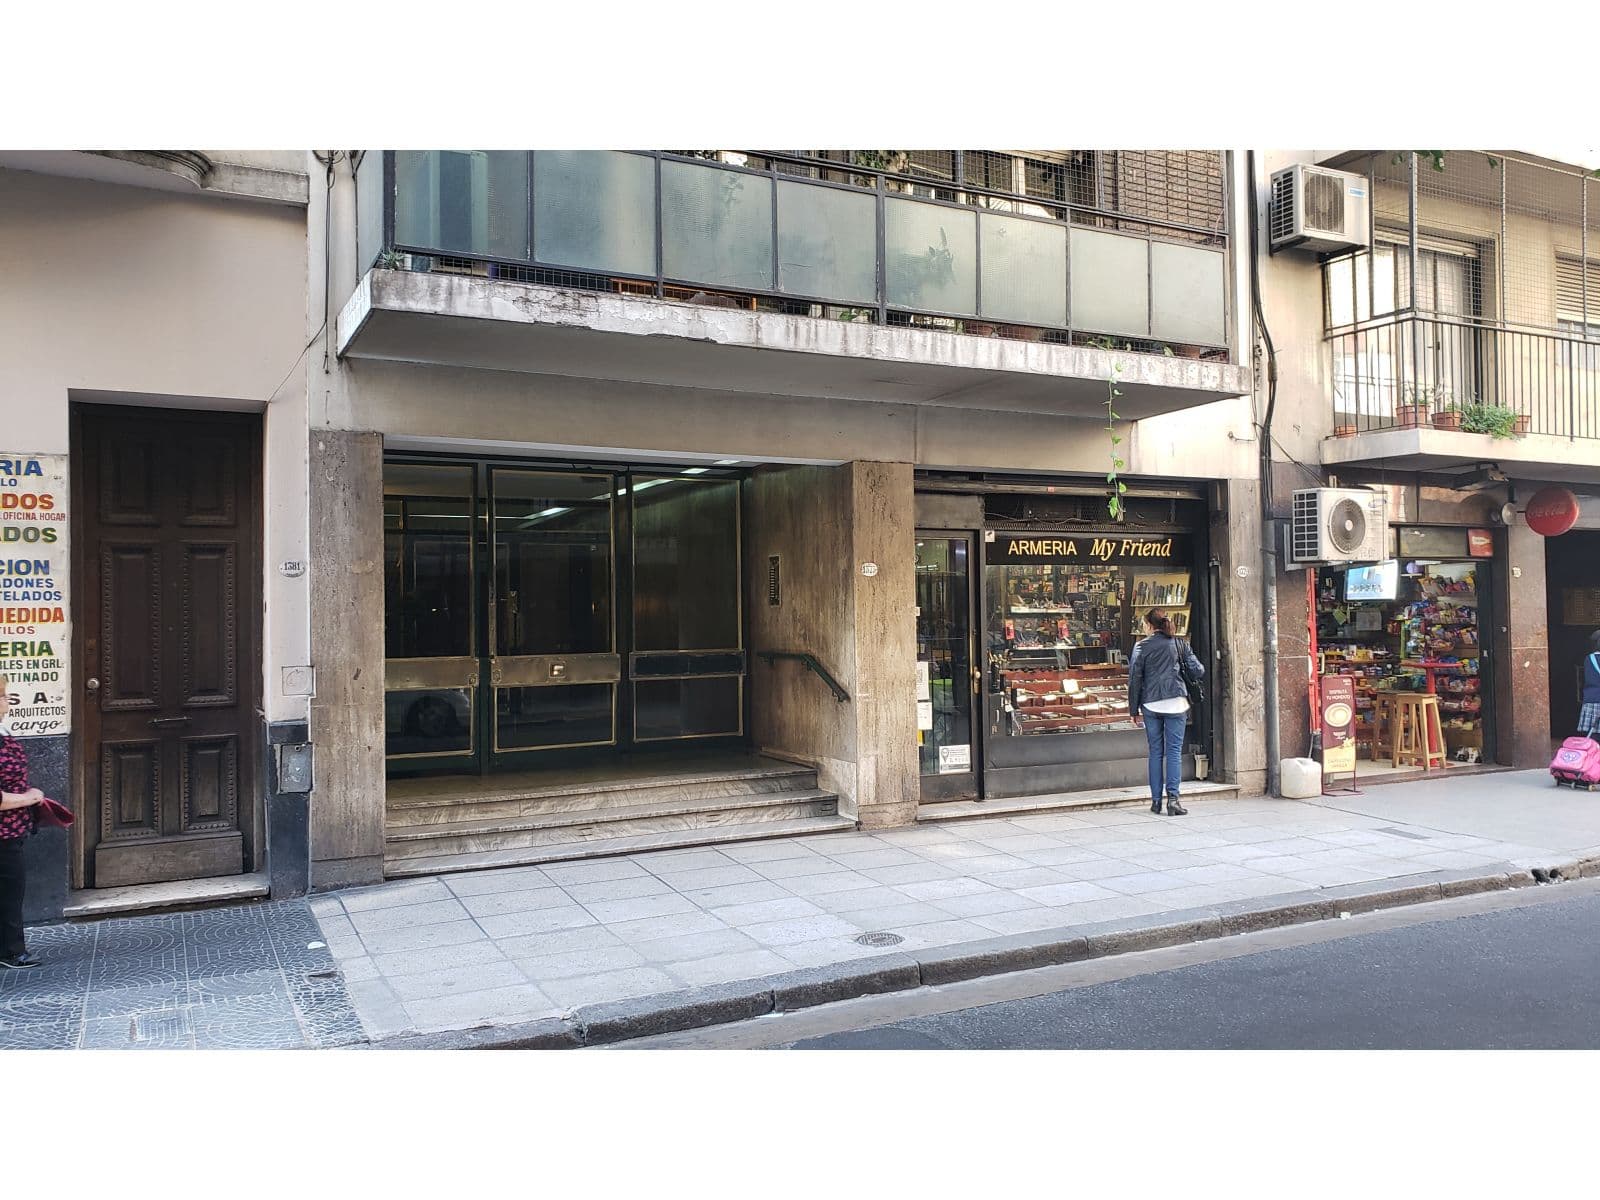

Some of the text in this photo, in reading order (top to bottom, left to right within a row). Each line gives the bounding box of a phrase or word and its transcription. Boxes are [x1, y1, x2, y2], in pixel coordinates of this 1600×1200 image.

[3, 511, 66, 521] OFICINA HOGAR
[0, 526, 58, 543] DOS
[1008, 538, 1172, 561] ARMERIA My Friend
[0, 578, 54, 588] DONES
[0, 591, 62, 601] ELADOS
[0, 607, 65, 623] EDIDA
[0, 625, 35, 635] ILOS
[0, 660, 23, 670] LES
[27, 660, 40, 669] EN
[9, 706, 66, 718] ARQUITECTOS
[11, 719, 62, 734] cargo
